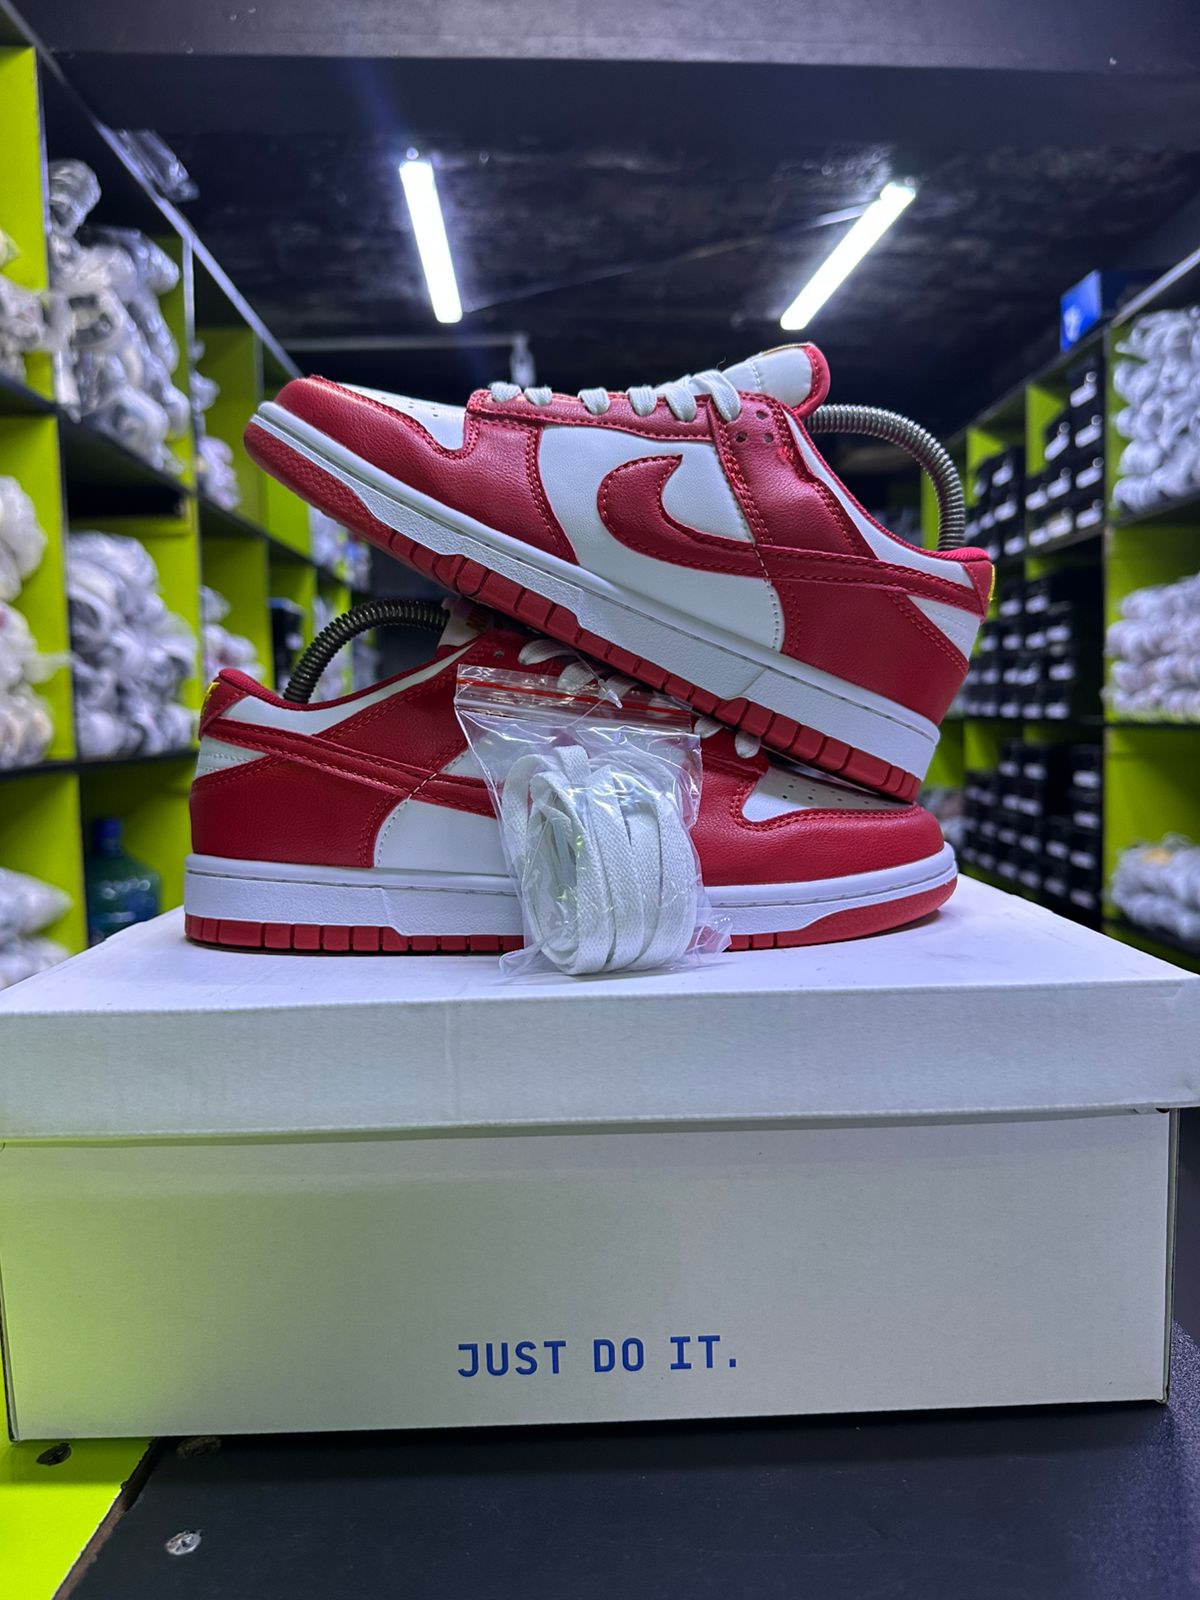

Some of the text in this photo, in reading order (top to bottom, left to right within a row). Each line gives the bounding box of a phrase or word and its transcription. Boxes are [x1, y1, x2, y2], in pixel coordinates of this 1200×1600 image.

[457, 1335, 737, 1377] JUST DO IT.
